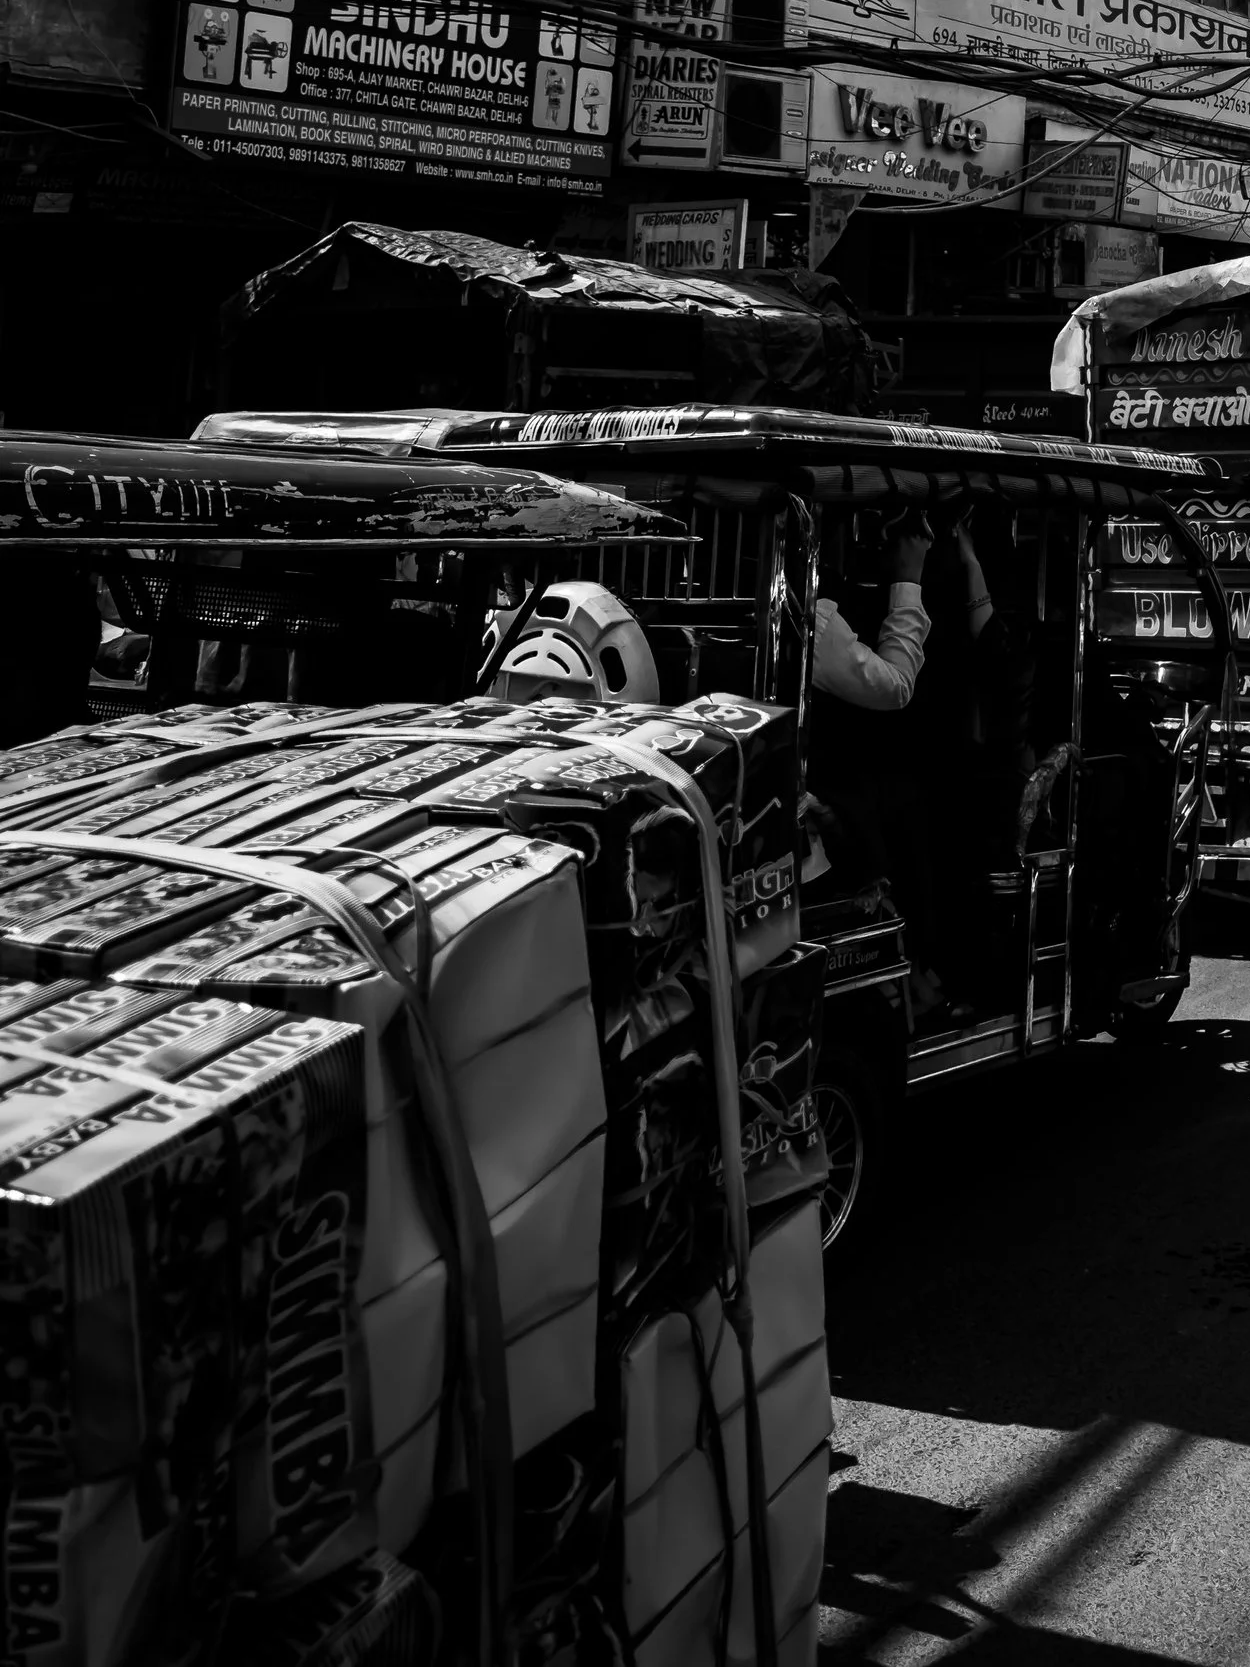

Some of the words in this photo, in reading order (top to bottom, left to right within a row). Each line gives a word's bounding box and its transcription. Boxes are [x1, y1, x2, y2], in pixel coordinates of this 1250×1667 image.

[989, 3, 1063, 39] प्रकाशक
[1066, 23, 1092, 47] एवं
[303, 25, 446, 76] MACHINERY
[451, 49, 527, 89] HOUSE
[634, 55, 719, 84] DIARIES
[295, 61, 321, 79] Shop
[328, 68, 356, 84] 695-A,
[359, 70, 384, 88] AJAY
[385, 74, 426, 90] MARKET,
[427, 81, 464, 97] CHAWRI
[464, 86, 496, 104] BAZAR,
[498, 91, 529, 108] DELHI-6
[300, 83, 328, 100] Office
[335, 89, 354, 104] 377,
[356, 90, 389, 107] CHITLA
[391, 94, 418, 112] GATE,
[420, 98, 457, 115] CHAWRI
[457, 104, 489, 122] BAZAR,
[491, 109, 523, 125] DELHI-6
[631, 84, 666, 101] SPIRAL
[666, 85, 715, 102] REGISTERS
[182, 92, 221, 111] PAPER
[224, 97, 279, 119] PRINTING,
[281, 105, 330, 126] CUTTING,
[332, 112, 380, 132] RULLING,
[381, 119, 435, 140] STITCHING,
[436, 125, 467, 142] MICRO
[468, 129, 534, 152] PERFORATING,
[535, 139, 572, 155] CUTTING
[573, 143, 606, 159] KNIVES,
[837, 84, 914, 141] Vee
[917, 97, 988, 153] Vee
[228, 117, 298, 140] LAMINATION,
[300, 126, 331, 143] BOOK
[334, 130, 377, 150] SEWING,
[379, 135, 416, 154] SPIRAL,
[418, 140, 444, 156] WIRO
[446, 144, 483, 161] BINDING
[485, 149, 492, 161] &
[493, 150, 526, 166] ALLIED
[527, 153, 572, 171] MACHINES
[809, 146, 878, 177] esigner
[213, 138, 286, 162] 011-45007303,
[289, 148, 349, 168] 9891143375,
[351, 155, 406, 173] 9811358627
[415, 161, 449, 177] Website
[455, 167, 514, 184] www.smh.co.in
[517, 172, 542, 187] E-mail
[546, 177, 603, 192] info@smh.co.in
[1158, 157, 1242, 195] NATIONA
[896, 186, 917, 197] DELHI
[642, 211, 681, 225] WEDDING
[682, 212, 720, 224] CARDS
[644, 239, 715, 269] WEDDING
[587, 406, 689, 439] AUTOMOBILES
[1109, 388, 1171, 429] बेटी
[1119, 523, 1175, 565] Use
[855, 949, 881, 965] Super
